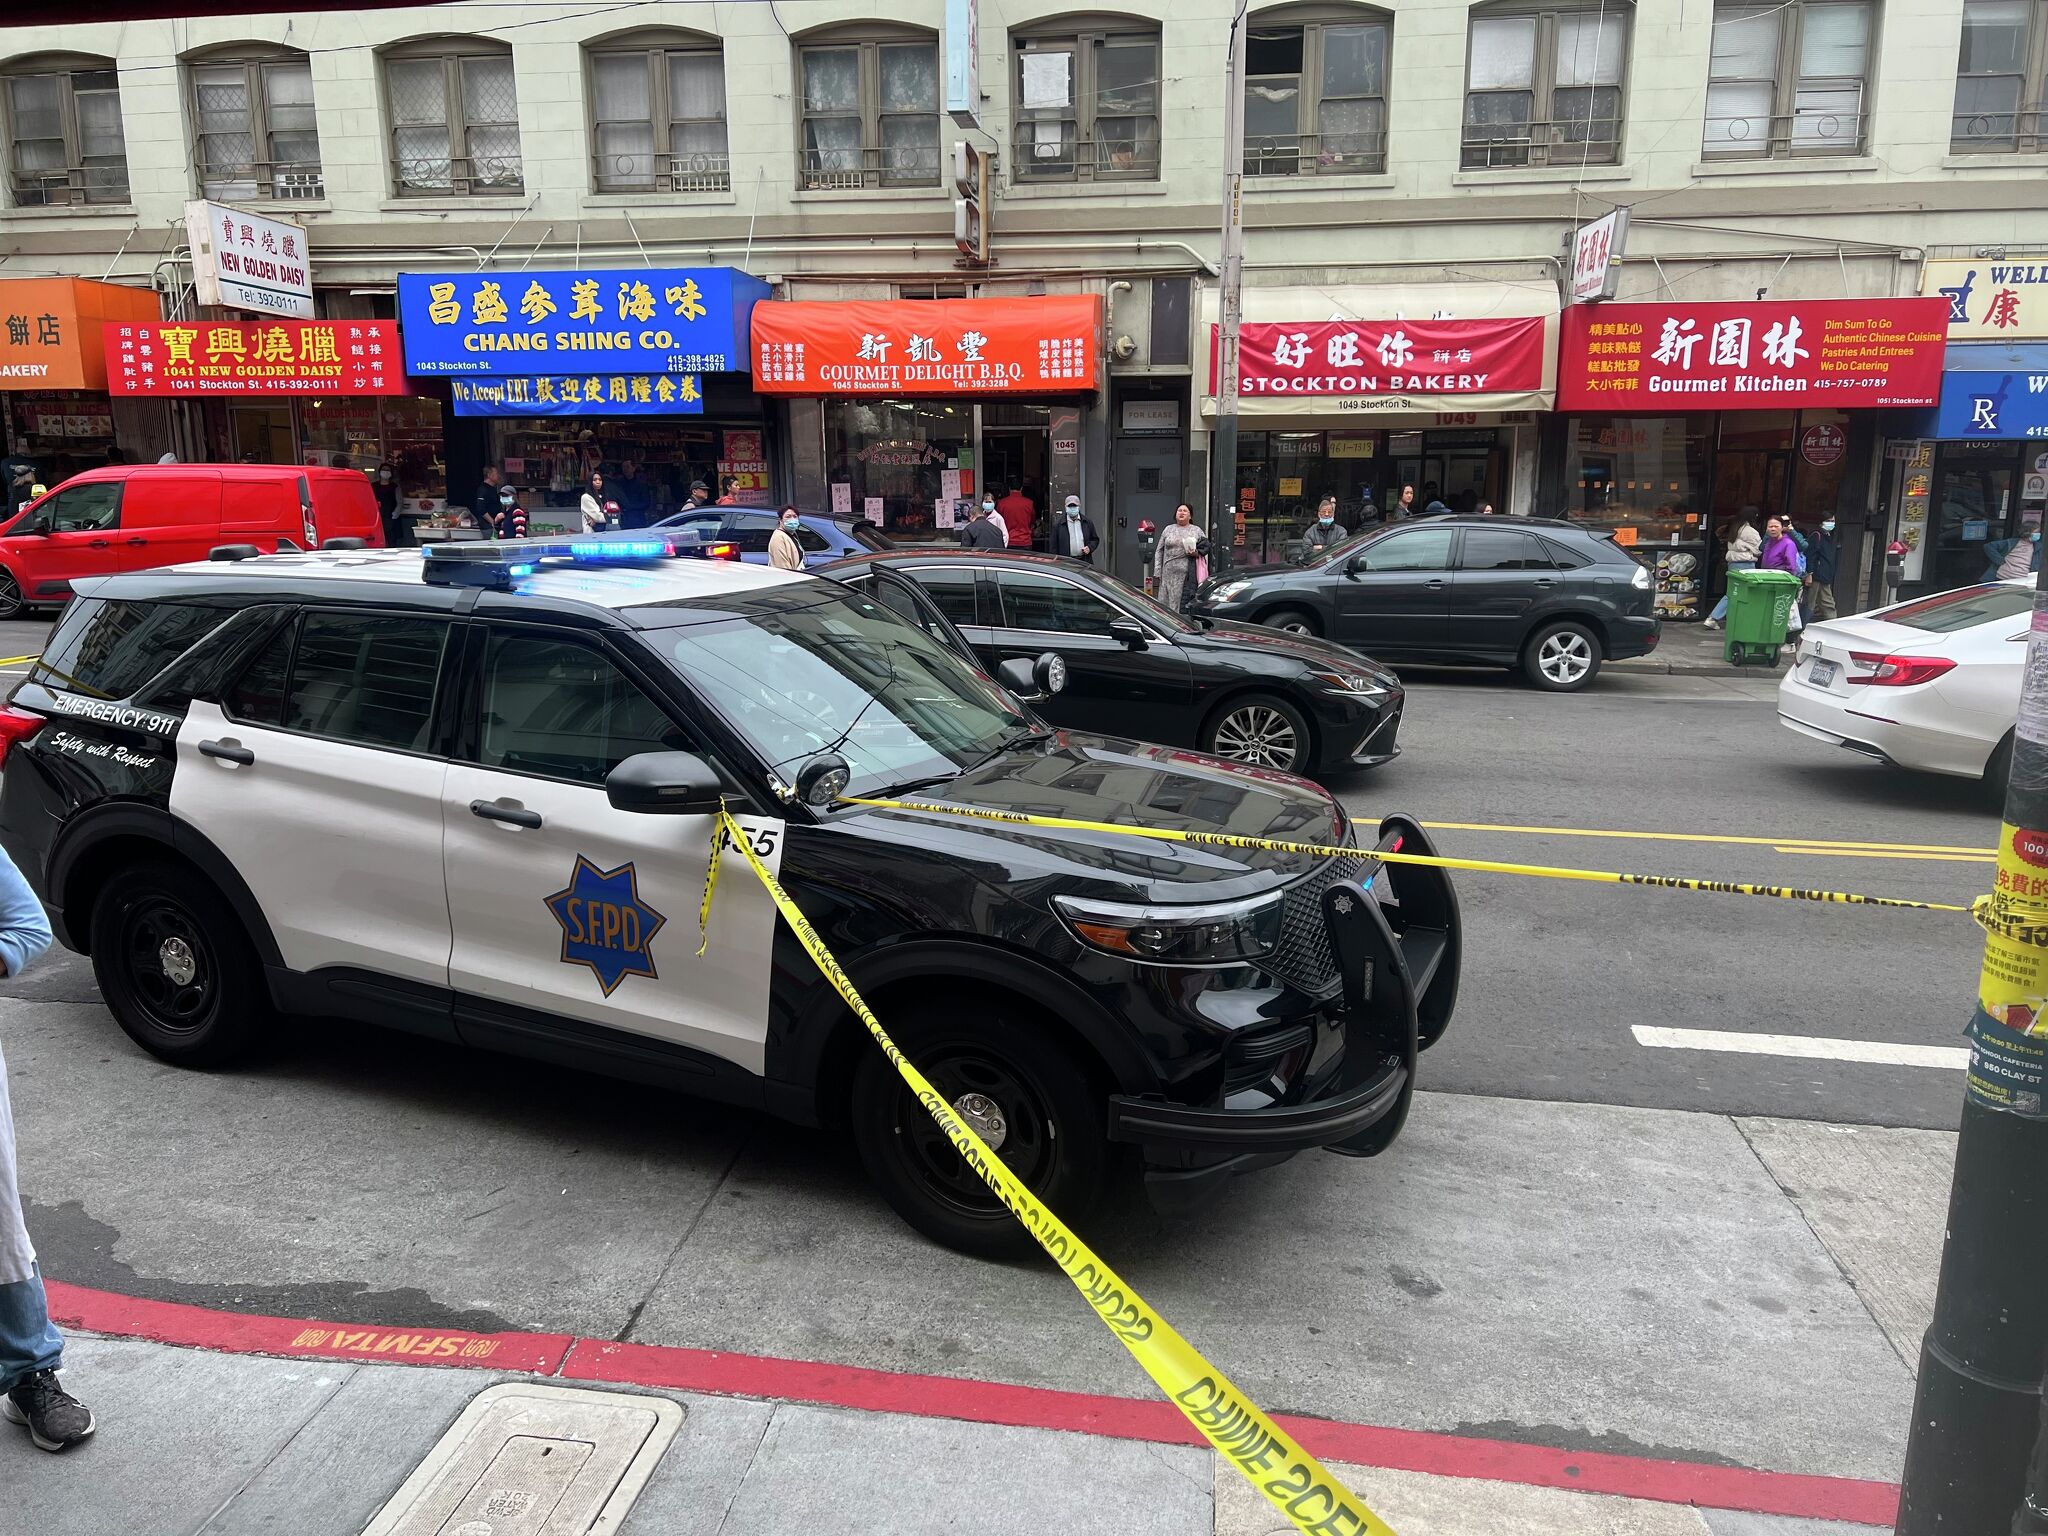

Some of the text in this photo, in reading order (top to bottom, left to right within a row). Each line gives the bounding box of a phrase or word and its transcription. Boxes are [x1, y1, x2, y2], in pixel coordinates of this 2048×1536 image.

[1576, 224, 1610, 277] 新園林
[221, 251, 305, 287] NEW GOLDEN DAISY
[238, 289, 298, 311] Tel: 392-0111
[1982, 288, 2021, 329] 康
[5, 313, 61, 346] 餅店
[1588, 322, 1642, 336] 精美點心
[1825, 318, 1892, 330] Dim Sum To Go
[159, 326, 341, 366] 寶興燒臘
[464, 330, 680, 352] CHANG SHING CO.
[856, 331, 988, 363] 新凱豐
[1650, 316, 1810, 371] 新園林
[1823, 332, 1942, 343] Authentic Chinese Cuisine
[667, 354, 725, 363] 415-398-4825
[1272, 330, 1473, 368] 好旺你 餅店
[1822, 346, 1914, 358] Pastries And Entrees
[0, 364, 48, 377] AKERY
[163, 365, 343, 376] 1041 NEW GOLDEN DAISY
[416, 361, 492, 371] 1043 Stockton St.
[667, 363, 725, 371] 415-203-3978
[820, 362, 1024, 381] GOURMET DELIGHT B.B.Q.
[1820, 361, 1889, 372] We Do Catering
[170, 380, 338, 389] 1041 Stockton St. 415-392-0111
[453, 382, 469, 401] We
[472, 382, 504, 405] Accept
[506, 379, 534, 403] EBT.
[832, 380, 902, 389] 1045 Stockton St.
[953, 379, 1009, 388] Tel: 392-3288
[1241, 373, 1490, 392] STOCKTON BAKERY
[1586, 378, 1639, 391] 大小布菲
[1648, 373, 1887, 394] Gourmet Kitchen 415-757-0789
[1338, 399, 1413, 410] 1049 Stockton St.
[1055, 441, 1075, 449] 1045
[1277, 443, 1321, 454] TEL: (415)
[53, 695, 175, 735] EMERGENCY 911
[51, 732, 155, 769] Safety with Respect
[2024, 841, 2044, 855] 100
[567, 897, 644, 954] S.F.P.D.
[1980, 1046, 2002, 1061] SCHOOL
[2002, 1056, 2043, 1070] CAFETERIA
[1984, 1061, 2042, 1084] 950 CLAY ST
[331, 1330, 467, 1356] SFMTA
